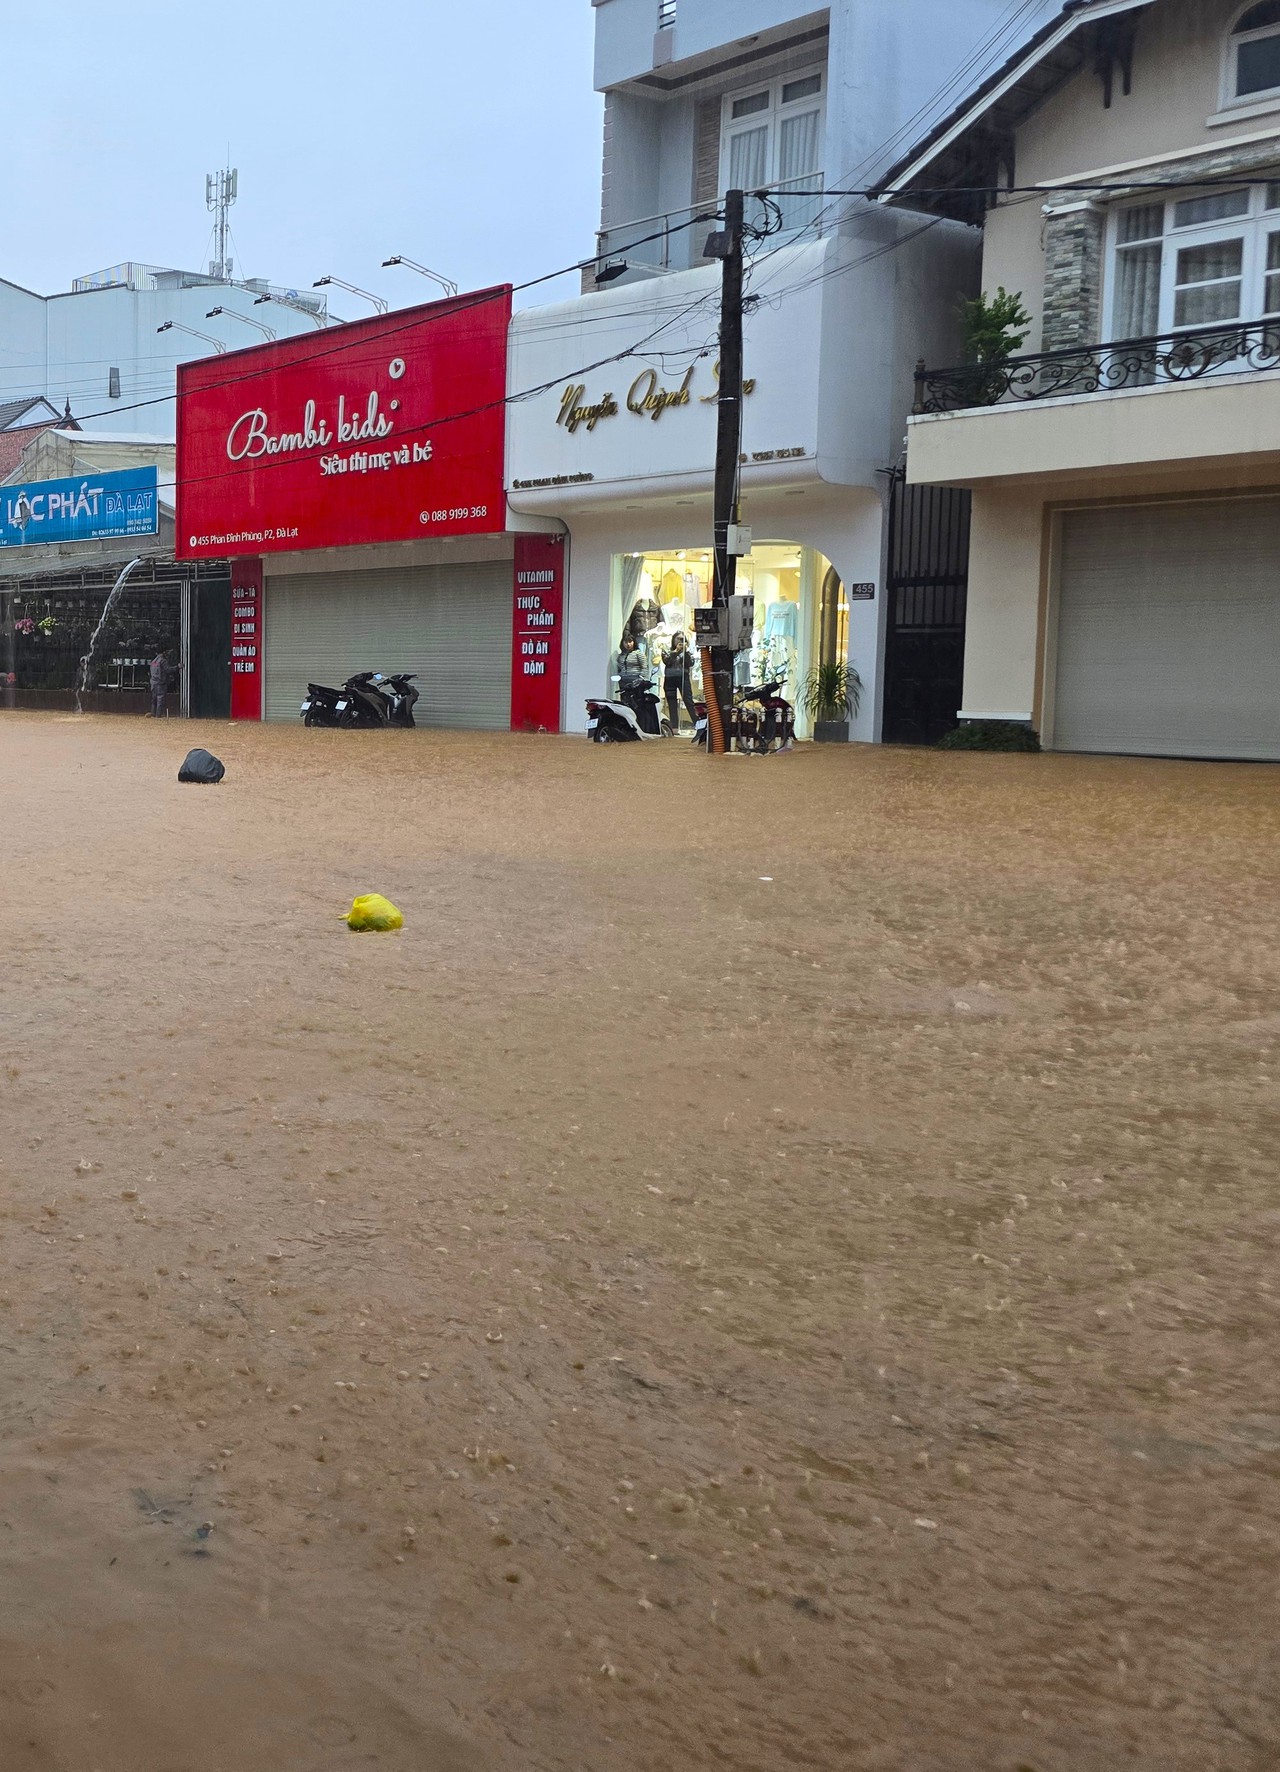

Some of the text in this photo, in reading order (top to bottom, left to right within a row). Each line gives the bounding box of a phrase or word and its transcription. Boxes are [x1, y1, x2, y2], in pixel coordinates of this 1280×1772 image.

[227, 391, 394, 461] Bambi kids
[320, 440, 433, 476] Siêu thị mẹ và bé
[48, 481, 104, 519] PHÁT
[106, 492, 124, 514] ĐÀ
[127, 492, 153, 514] LẠT
[431, 505, 487, 522] 088 9199 368
[198, 536, 209, 546] 455
[210, 535, 226, 544] Phan
[226, 532, 241, 543] Đình
[264, 529, 276, 541] P2,
[276, 527, 286, 538] Đà
[286, 527, 299, 539] Lạt
[517, 569, 554, 584] VITAMIN
[856, 584, 874, 593] 455
[517, 595, 540, 610] THỰC
[234, 607, 255, 618] COMBO
[527, 609, 554, 626] PHẨM
[241, 622, 255, 633] SINH
[247, 644, 256, 656] ÁO
[522, 638, 548, 655] ĐỒ ĂN
[244, 661, 255, 672] EM
[523, 660, 545, 676] DẶM
